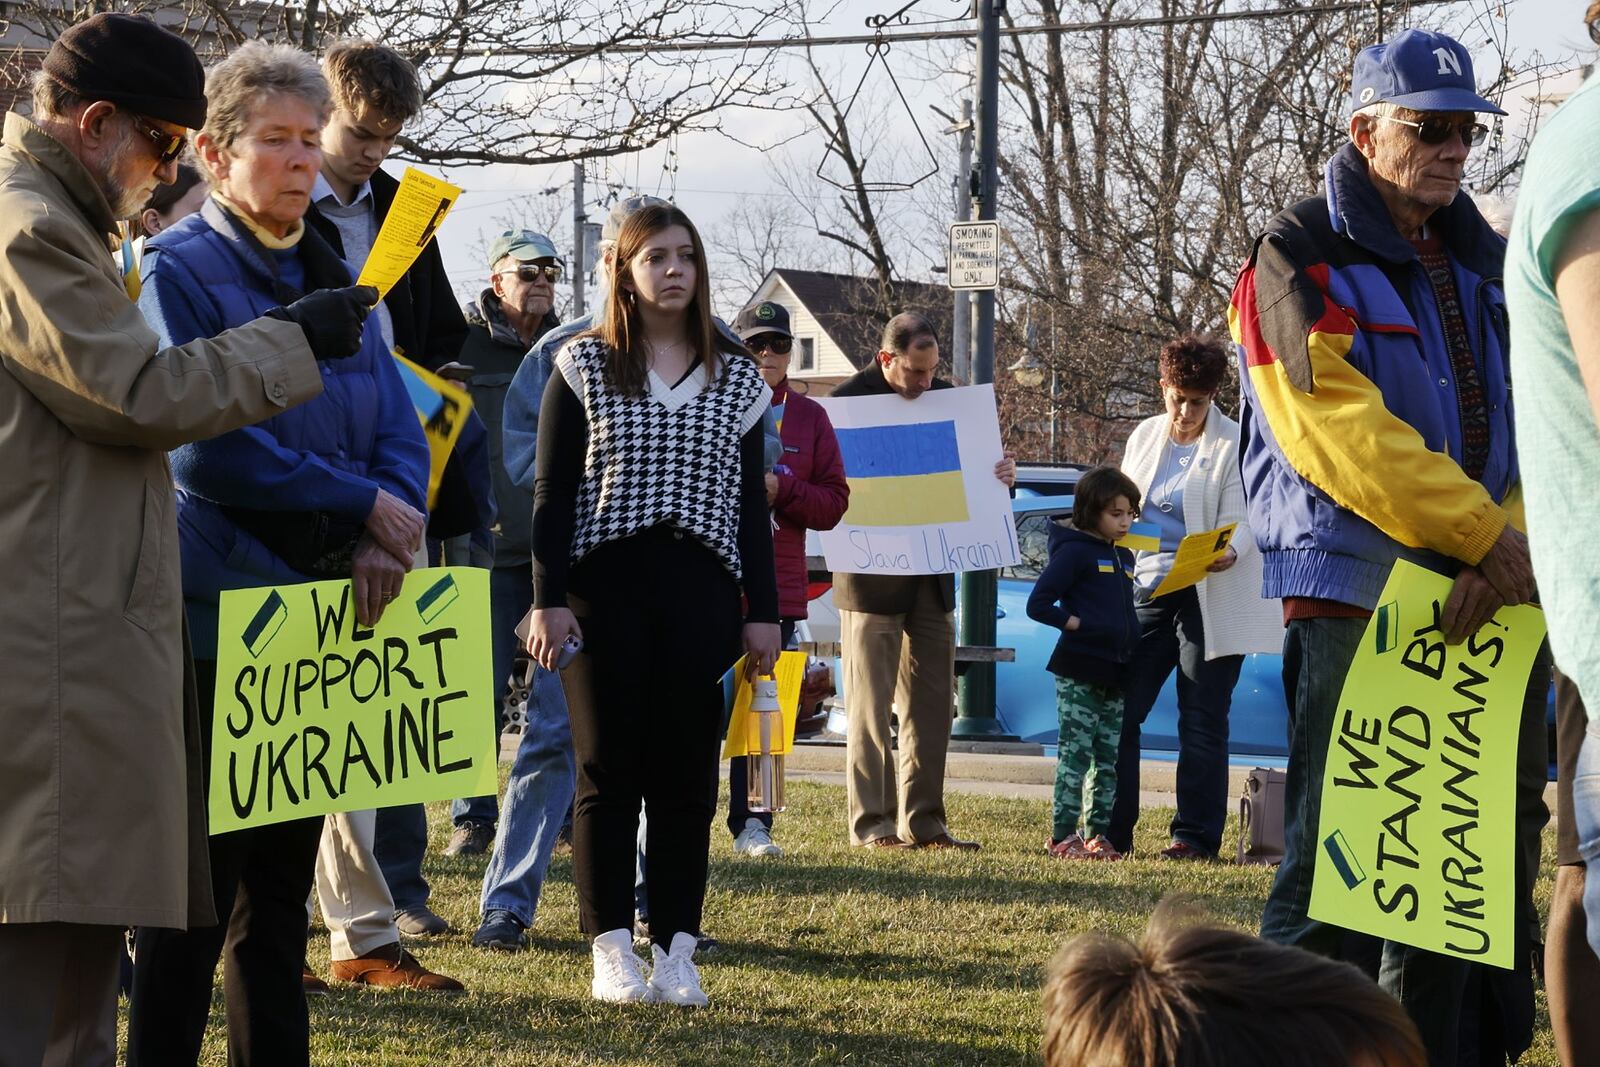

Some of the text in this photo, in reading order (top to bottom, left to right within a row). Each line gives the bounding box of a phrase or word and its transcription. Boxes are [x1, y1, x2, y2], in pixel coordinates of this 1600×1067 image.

[1432, 47, 1462, 76] N
[956, 228, 992, 239] SMOKING
[964, 271, 983, 281] ONLY
[849, 529, 912, 570] Slava
[226, 627, 458, 740] SUPPORT
[228, 690, 473, 820] UKRAINE
[1334, 709, 1382, 789] WE
[1373, 599, 1447, 922] STAND BY
